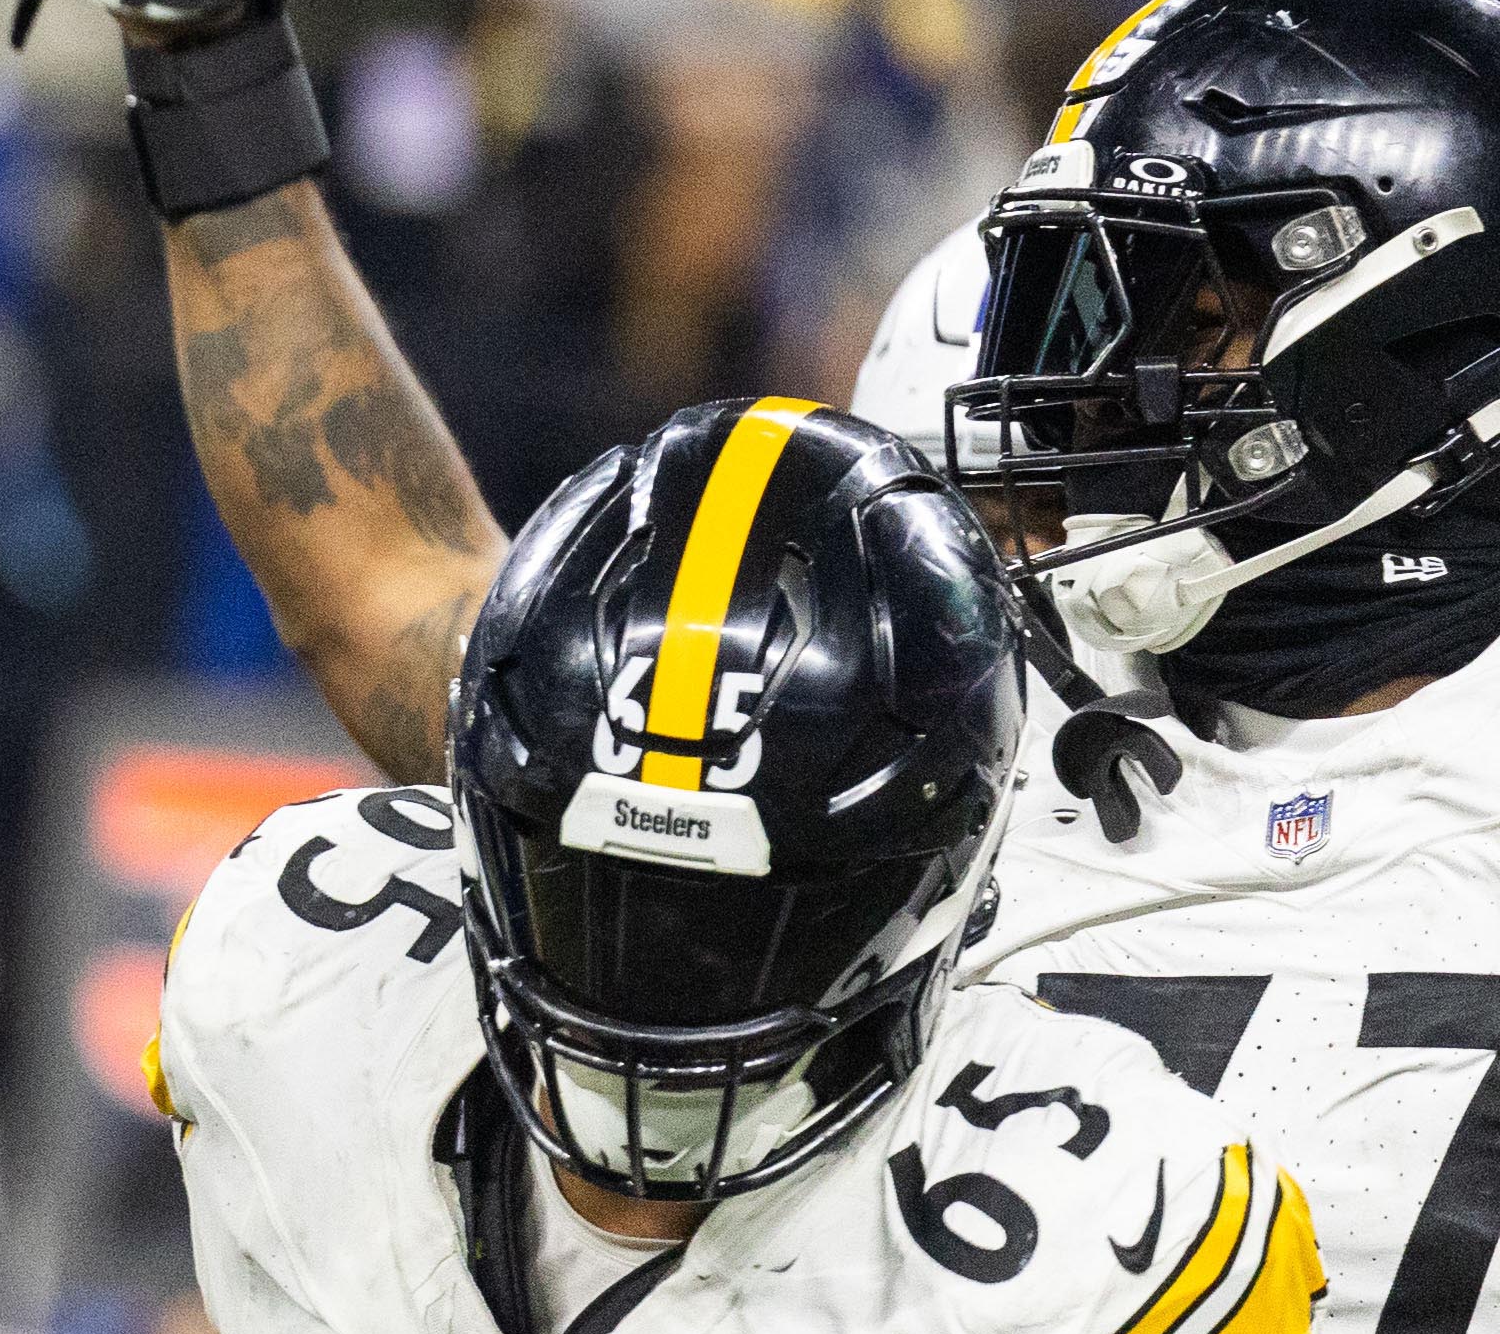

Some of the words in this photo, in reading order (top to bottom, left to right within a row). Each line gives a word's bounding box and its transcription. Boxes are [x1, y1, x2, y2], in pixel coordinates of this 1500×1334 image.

[593, 656, 764, 789] 65
[277, 788, 465, 964] 65
[615, 798, 711, 840] Steelers
[1276, 817, 1319, 845] NFL
[887, 1060, 1111, 1284] 65
